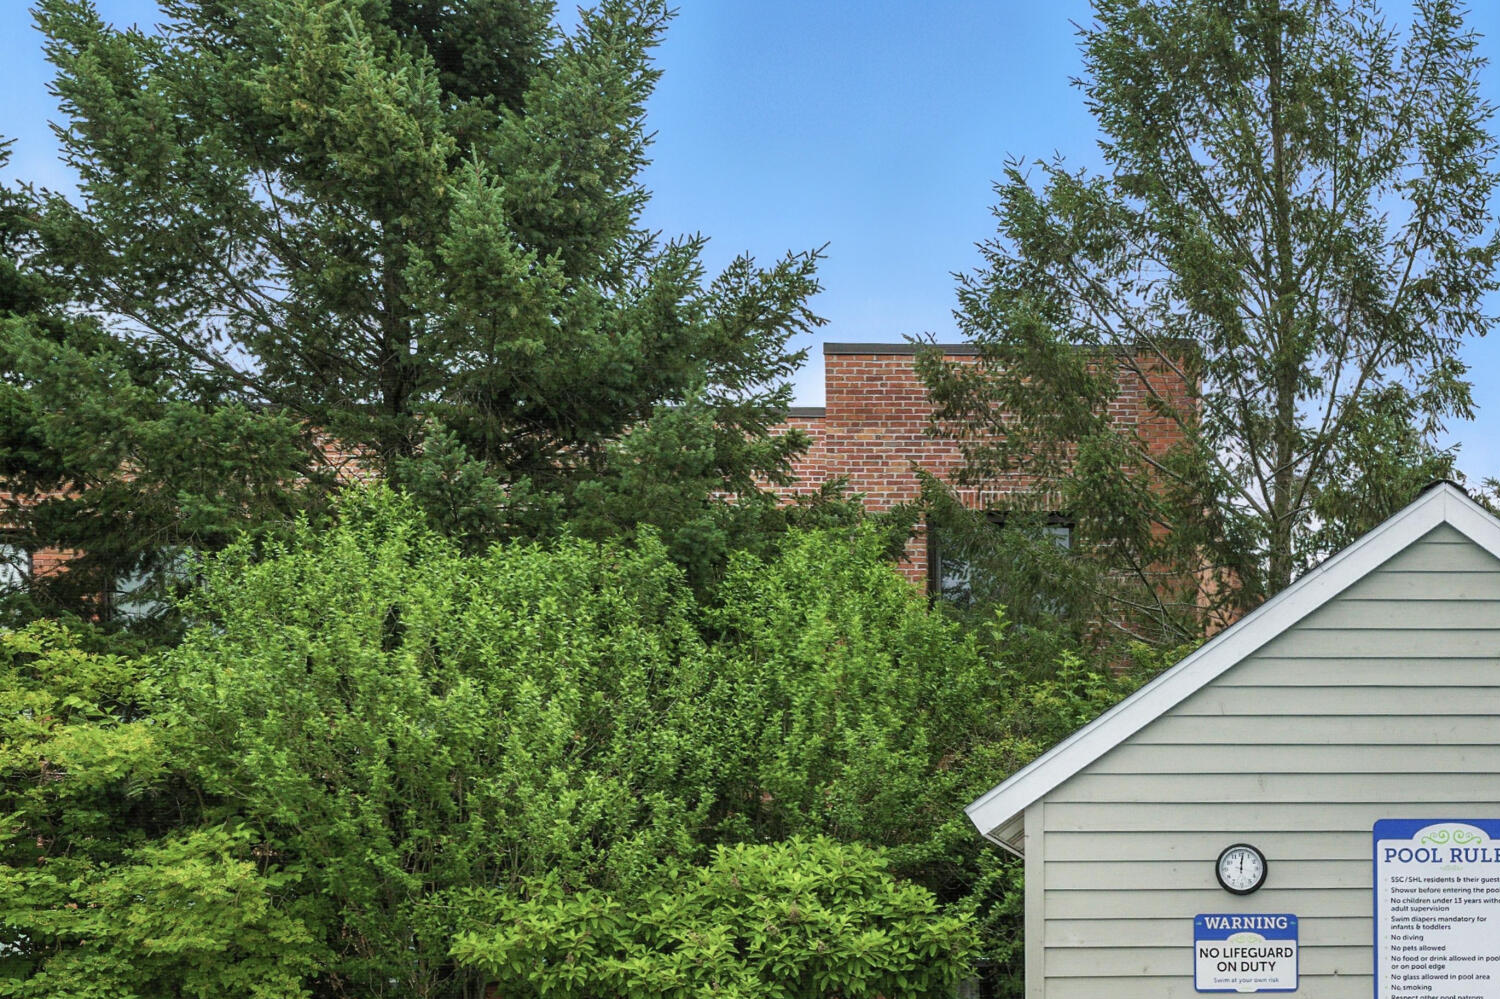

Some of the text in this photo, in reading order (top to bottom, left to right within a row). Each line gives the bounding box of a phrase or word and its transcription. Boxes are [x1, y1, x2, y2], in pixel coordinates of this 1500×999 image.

[1384, 848, 1442, 863] POOL
[1204, 917, 1287, 929] WARNING
[1200, 947, 1293, 958] NO LIFEGUARD
[1217, 962, 1276, 972] ON DUTY
